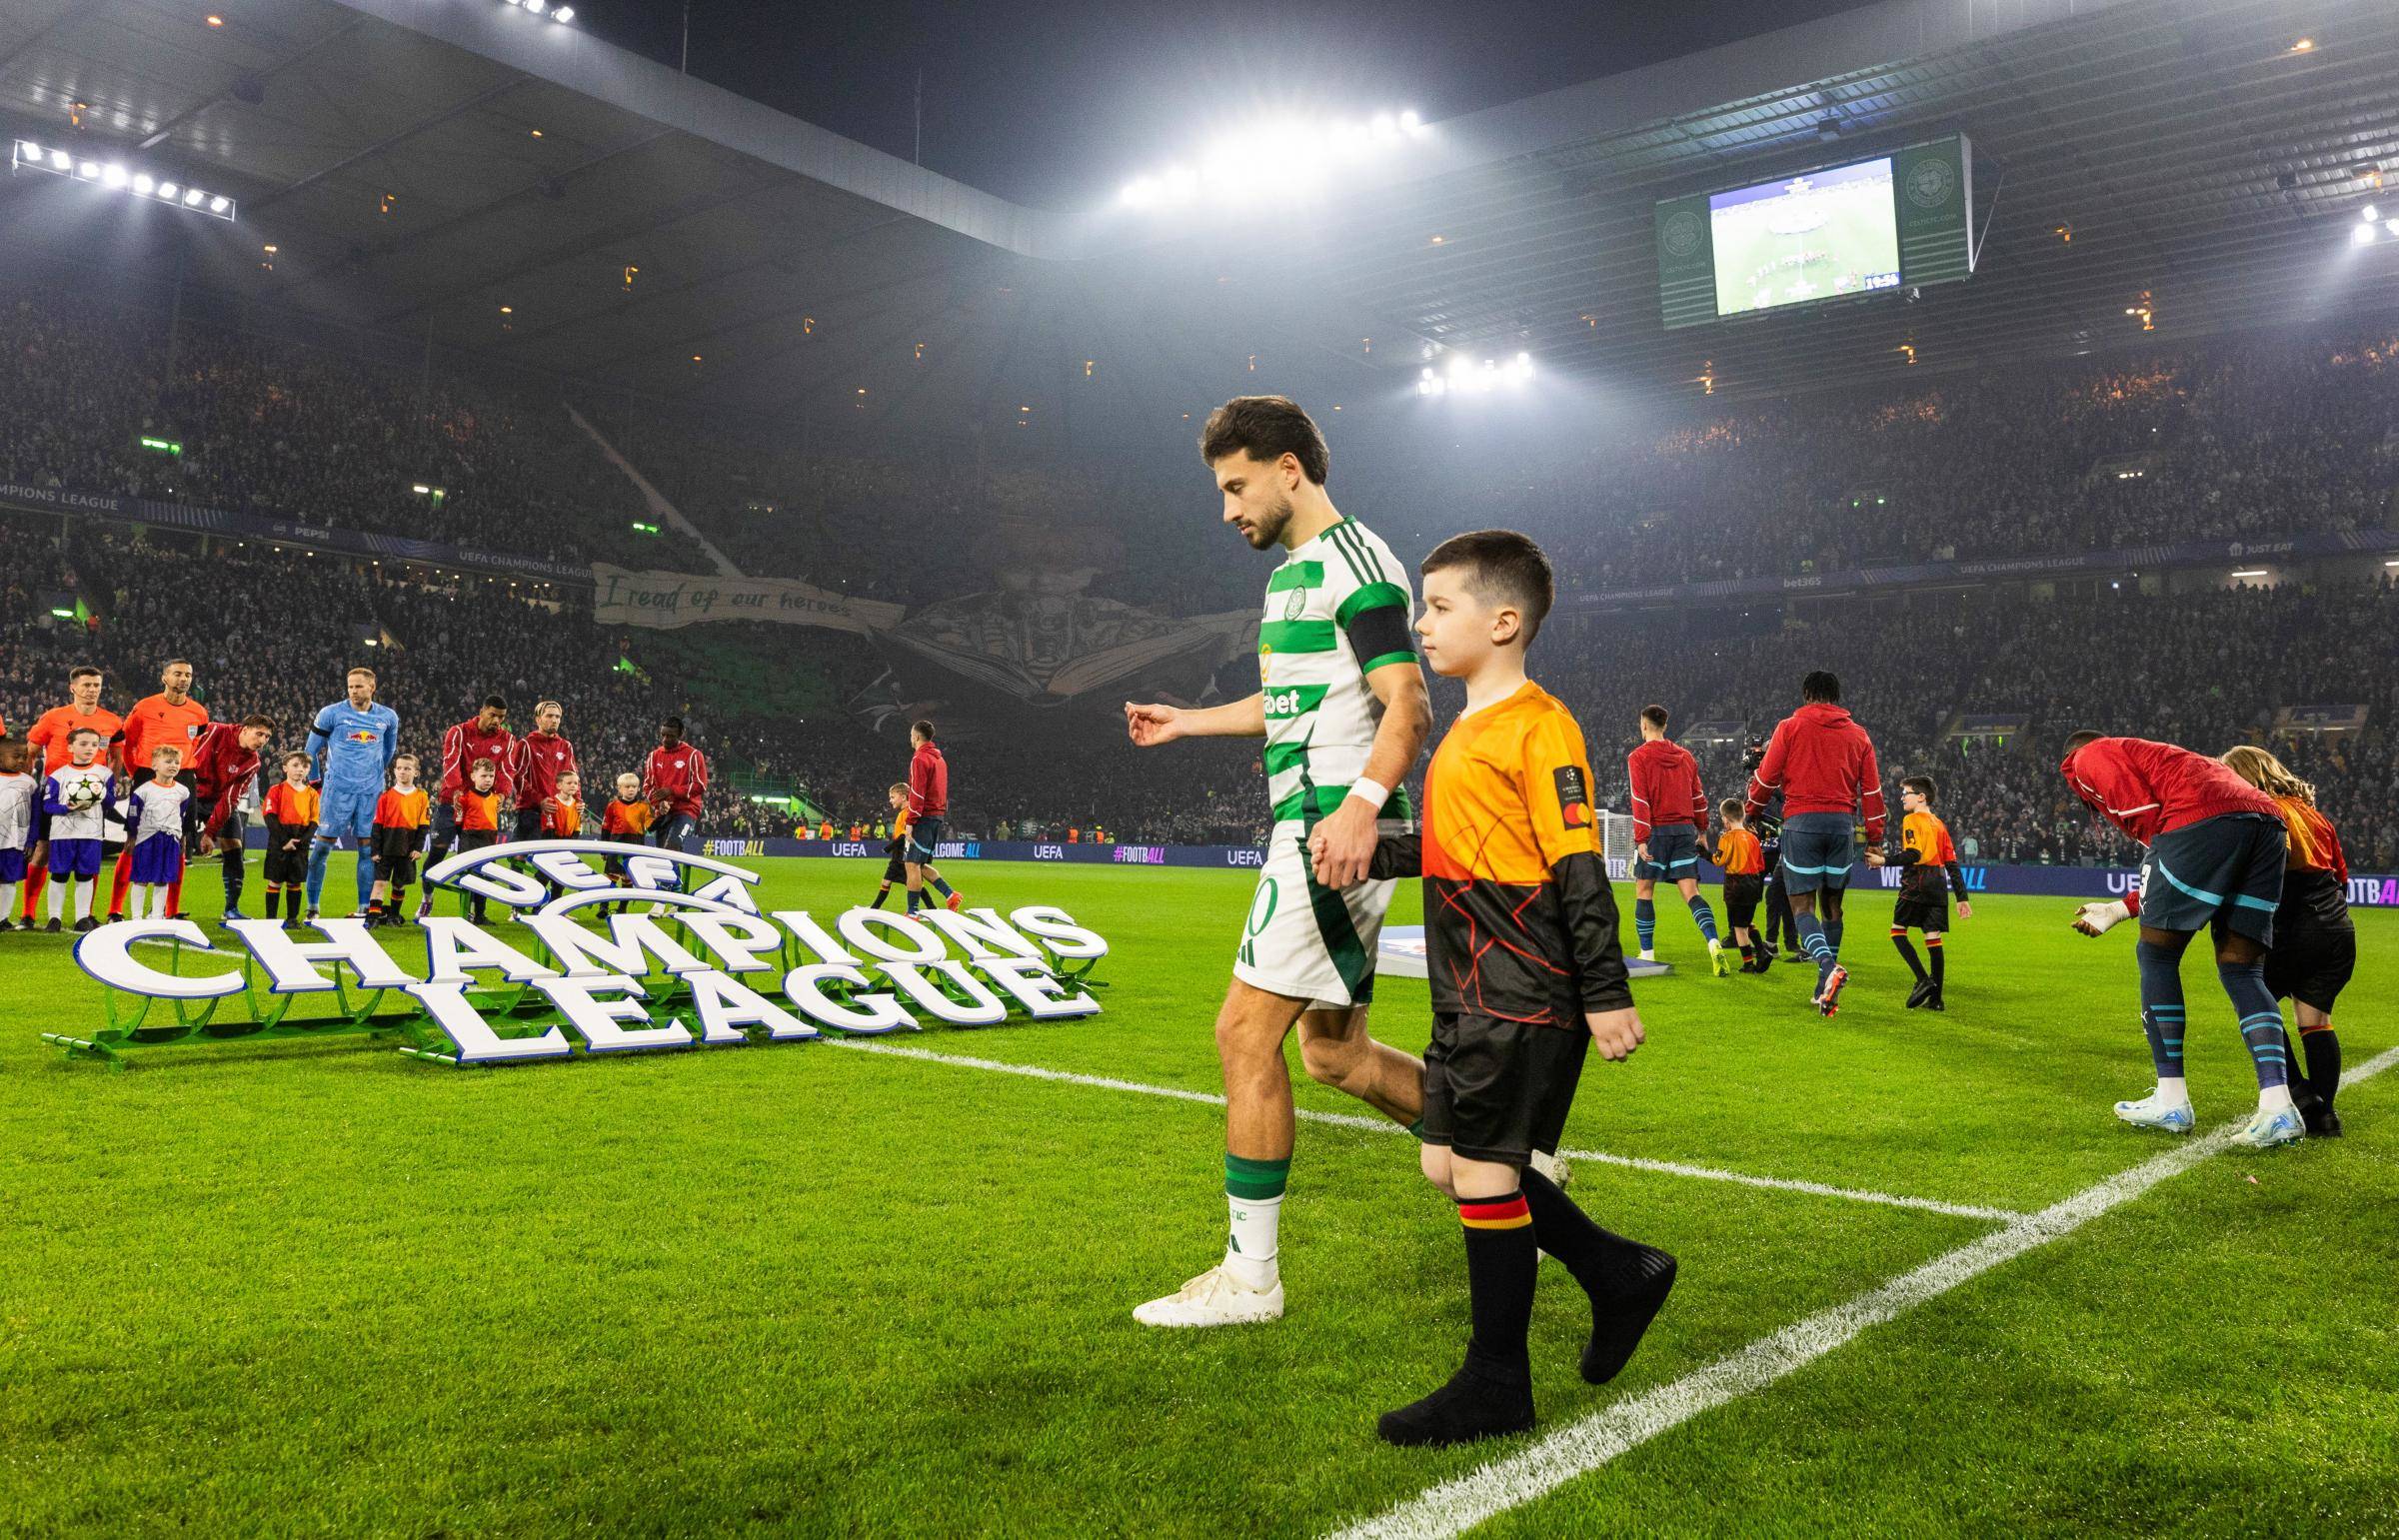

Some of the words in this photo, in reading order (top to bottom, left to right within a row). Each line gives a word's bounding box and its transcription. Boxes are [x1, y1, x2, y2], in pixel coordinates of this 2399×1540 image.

[61, 492, 119, 511] LEAGUE
[294, 526, 330, 540] PEPSI
[2245, 543, 2271, 555] JUST
[2272, 542, 2295, 552] EAT
[459, 551, 489, 564] UEFA
[491, 555, 553, 574] CHAMPIONS
[1959, 564, 1985, 574] UEFA
[1986, 559, 2044, 573] CHAMPIONS
[2046, 556, 2086, 568] LEAGUE
[1782, 576, 1822, 588] bet365
[628, 581, 686, 615] read
[691, 589, 720, 614] of
[731, 593, 771, 609] our
[703, 839, 765, 857] #FOOTBALL
[832, 842, 867, 857] UEFA
[933, 842, 965, 858] LCOME
[965, 842, 981, 858] ALL
[1034, 844, 1064, 859] UEFA
[1114, 845, 1165, 864] #FOOTBALL
[1227, 849, 1263, 865] UEFA
[456, 849, 762, 918] UEFA
[2107, 872, 2141, 893] UE
[73, 904, 1110, 998] CHAMPIONS
[402, 954, 1104, 1066] LEAGUE
